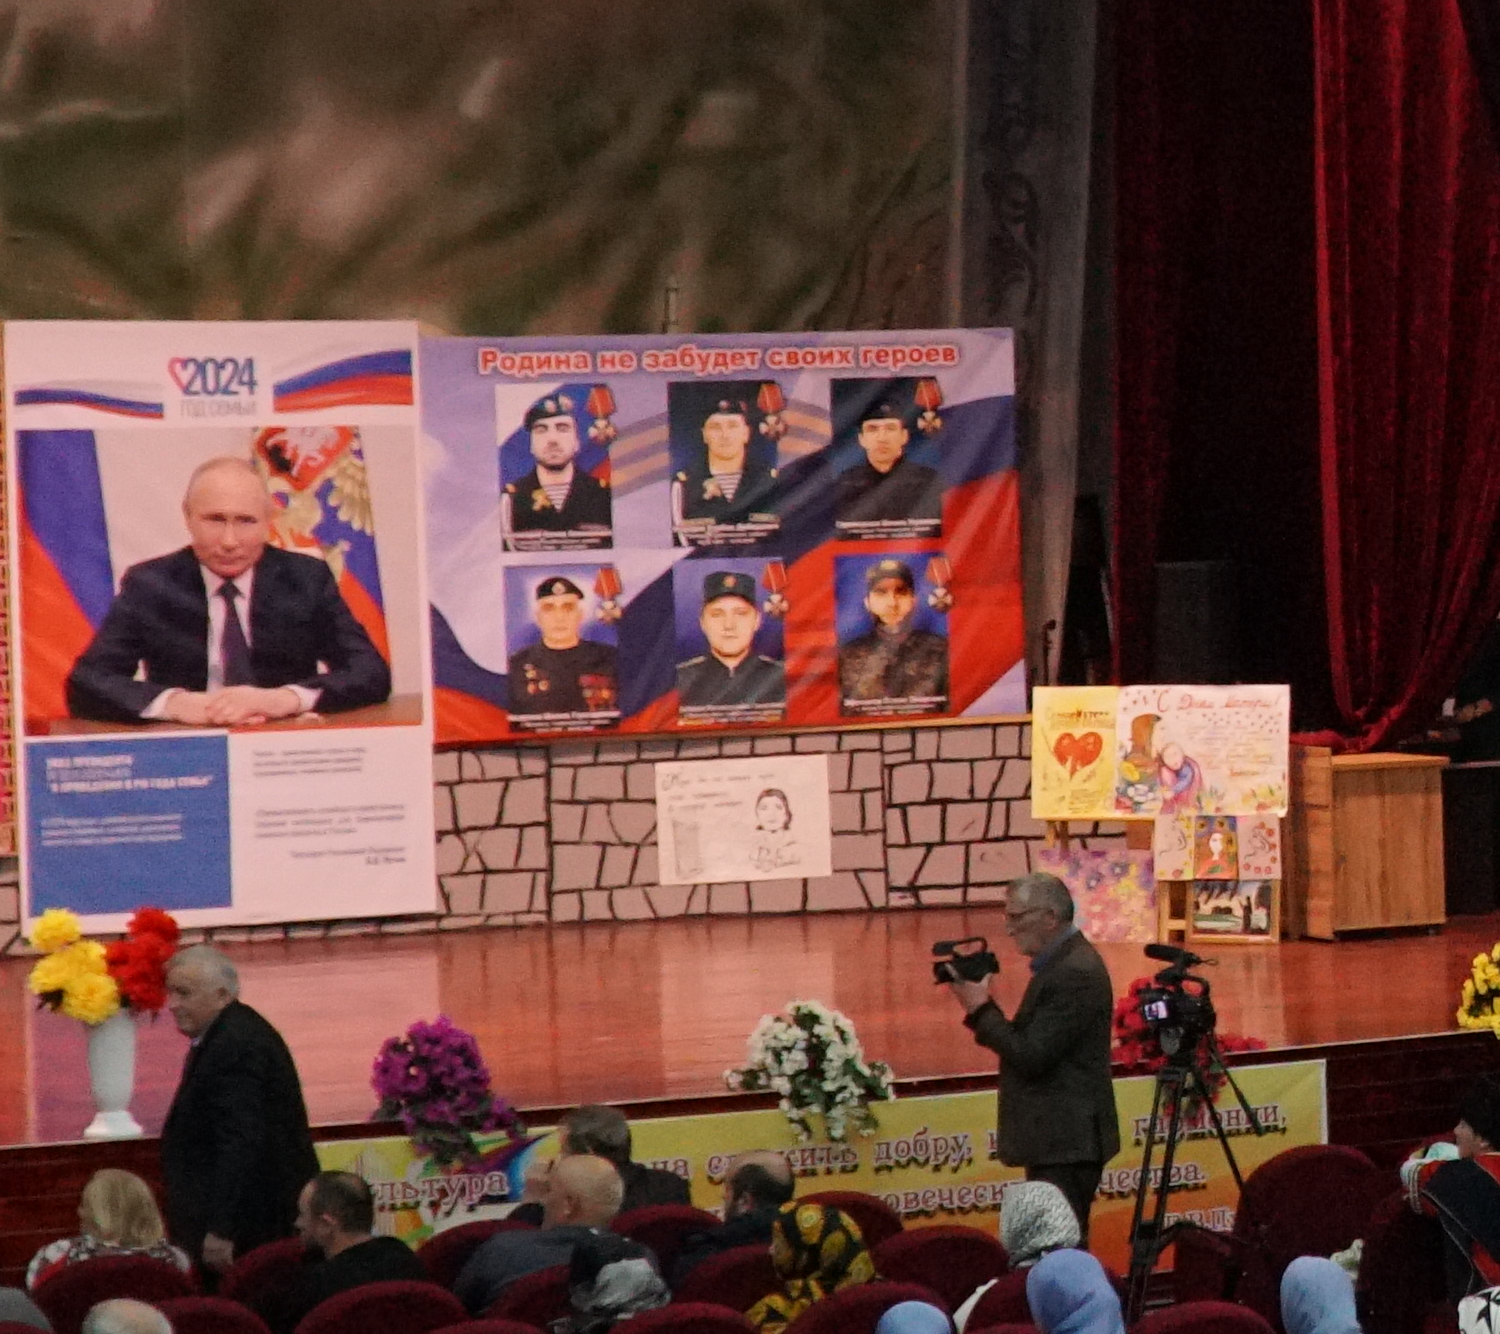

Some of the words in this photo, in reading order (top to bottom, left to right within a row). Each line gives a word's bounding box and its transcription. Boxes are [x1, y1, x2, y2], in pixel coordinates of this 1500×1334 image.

[181, 357, 257, 396] 2024
[479, 348, 592, 375] Родина
[598, 351, 636, 370] не
[643, 346, 760, 375] забудет
[766, 348, 852, 367] своих
[861, 346, 957, 368] героев
[372, 1172, 510, 1213] льтура
[875, 1126, 973, 1164] добру,
